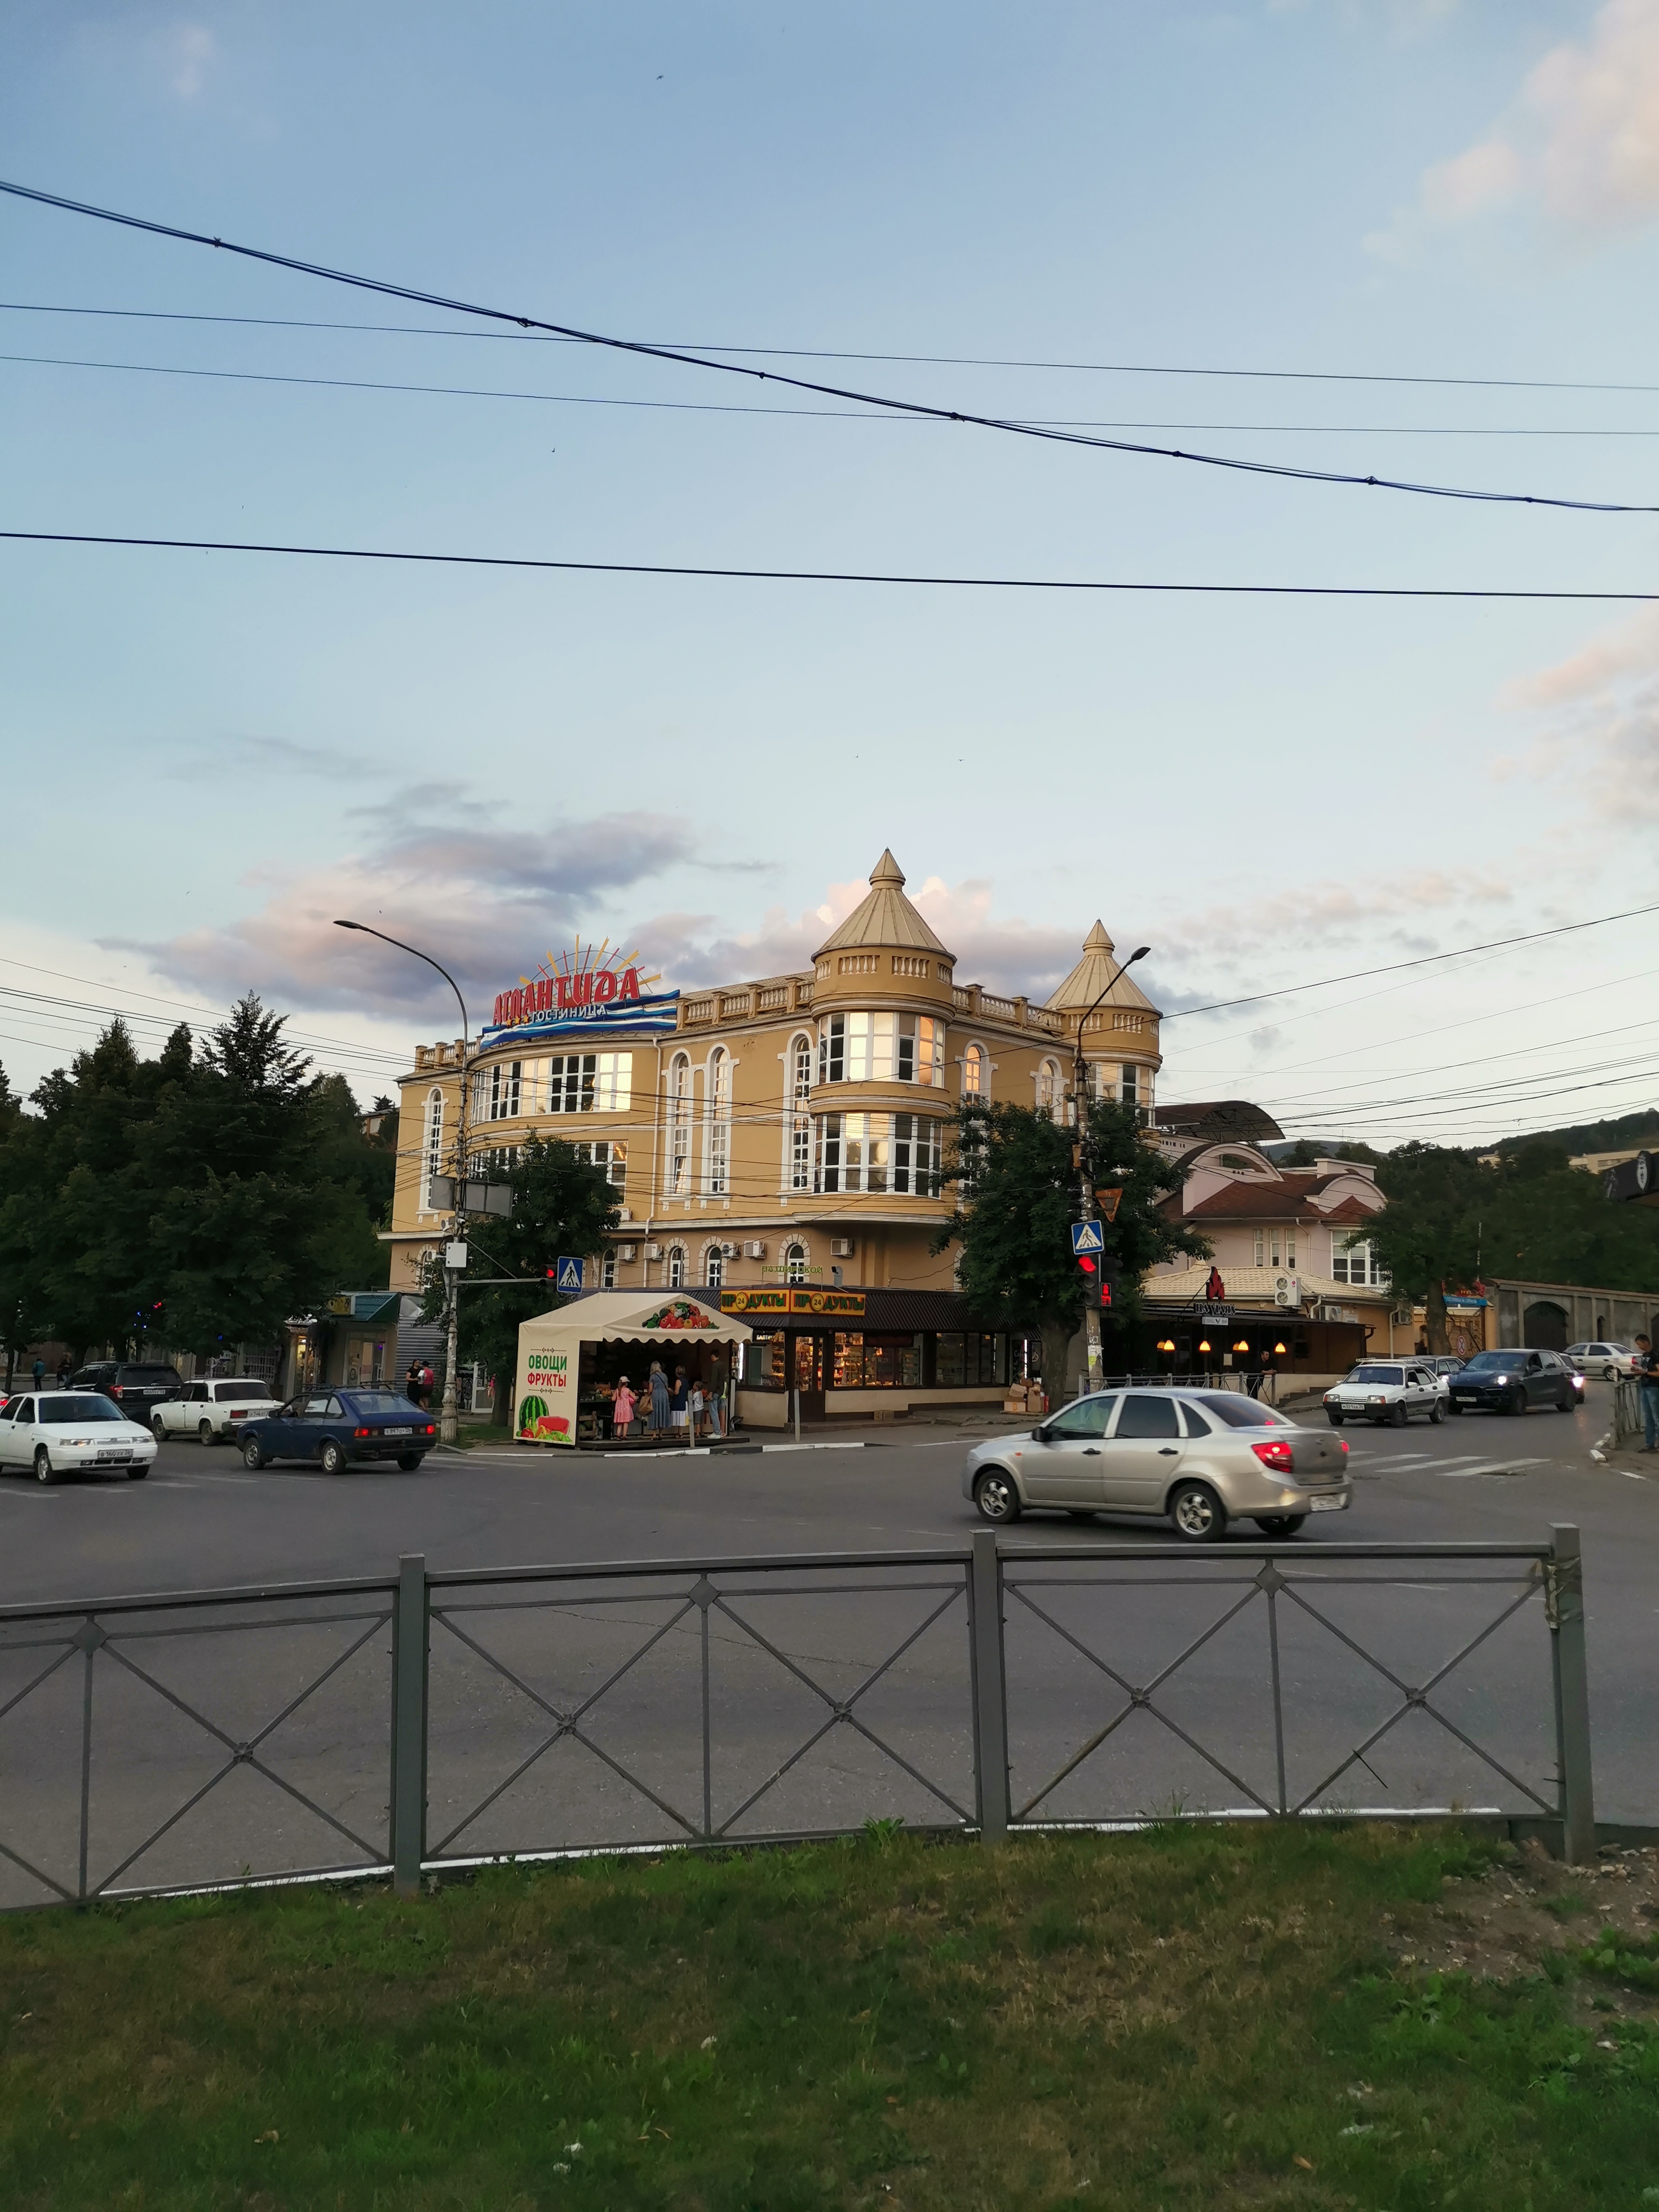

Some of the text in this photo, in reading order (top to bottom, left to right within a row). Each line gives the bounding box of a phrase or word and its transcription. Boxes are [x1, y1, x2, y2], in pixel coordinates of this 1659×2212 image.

[493, 967, 641, 1025] АТЛАНТИДА
[532, 1004, 607, 1022] ГОСТИНИЦА
[776, 1265, 823, 1274] ШИРОКОЙ
[529, 1355, 567, 1373] ОВОЩИ
[528, 1372, 566, 1387] ФРУКТЫ
